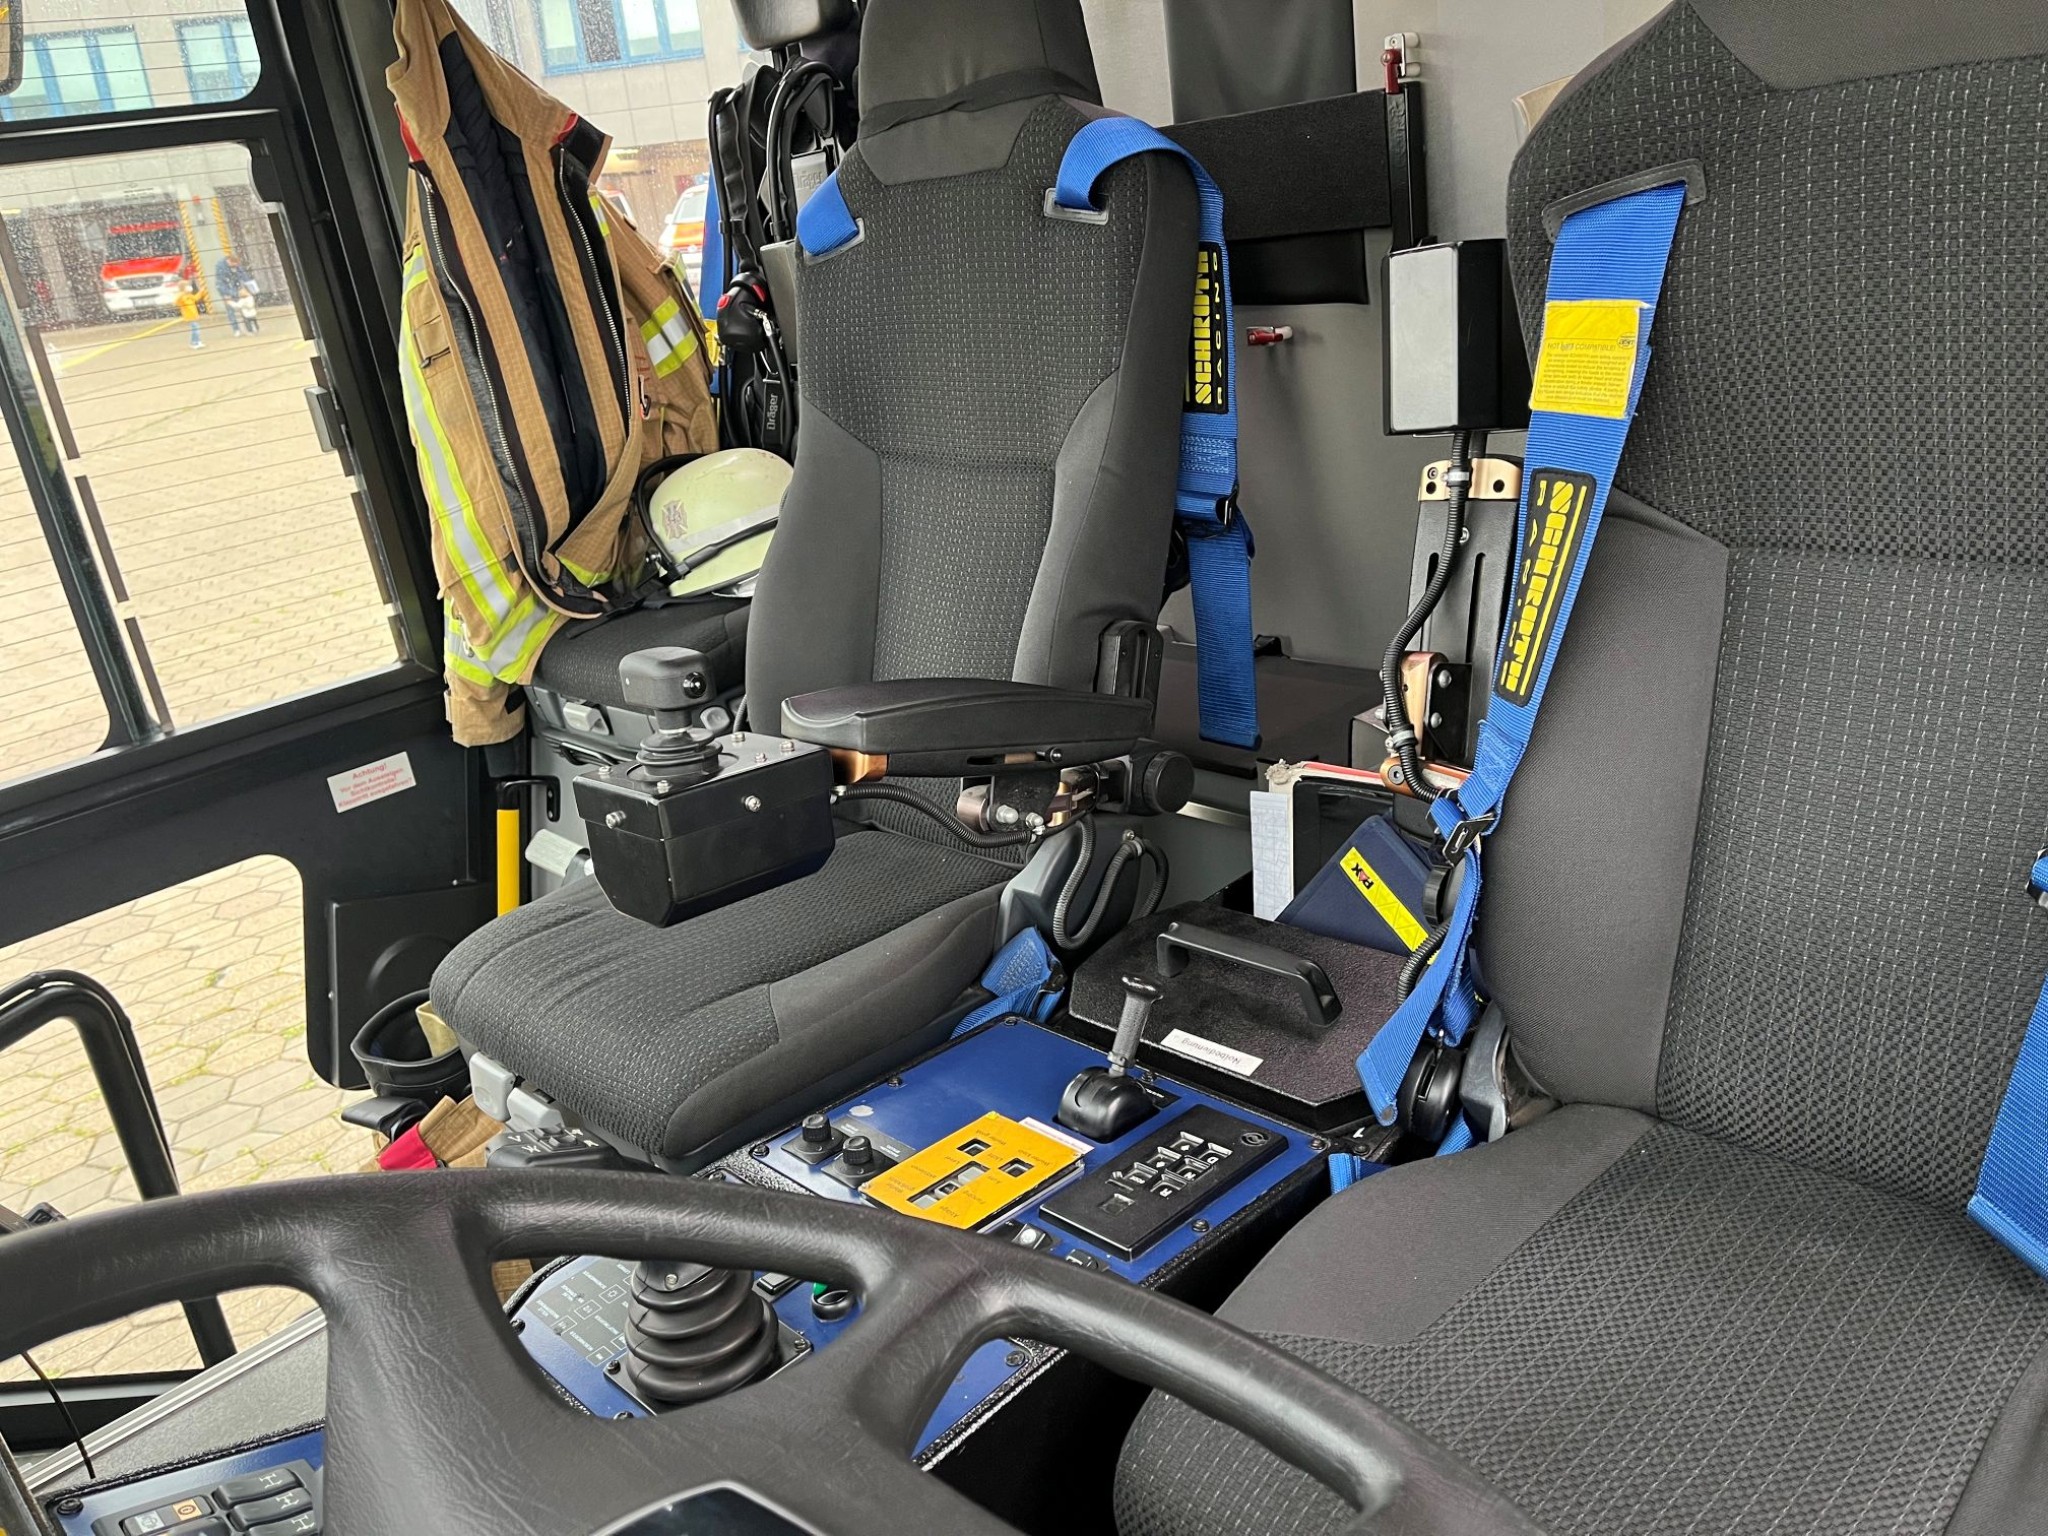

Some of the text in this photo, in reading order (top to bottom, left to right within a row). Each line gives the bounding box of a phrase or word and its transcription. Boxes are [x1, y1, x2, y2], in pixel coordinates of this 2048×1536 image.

[1194, 251, 1212, 405] SCHROTH
[1212, 251, 1223, 405] RACING
[766, 393, 779, 430] Dräger
[1505, 480, 1574, 692] SCHROTH
[352, 763, 387, 779] Achtung!
